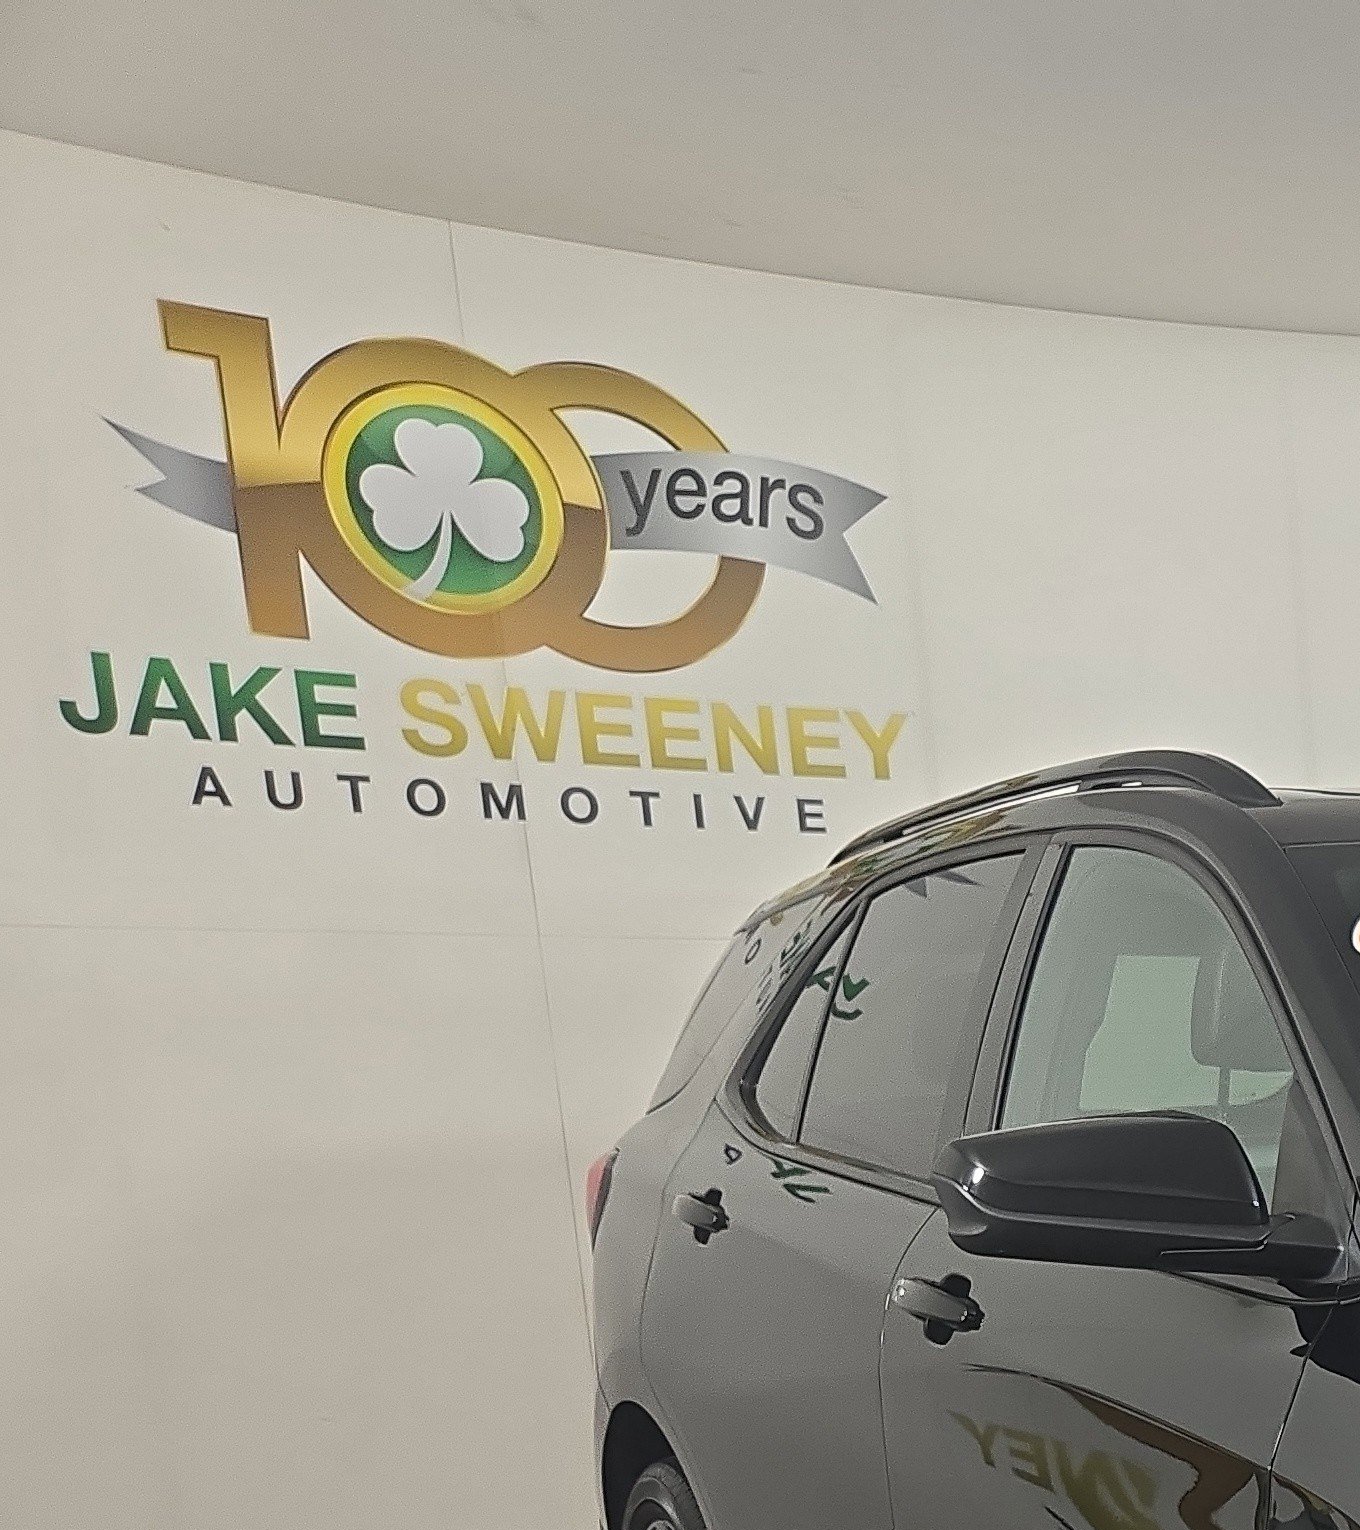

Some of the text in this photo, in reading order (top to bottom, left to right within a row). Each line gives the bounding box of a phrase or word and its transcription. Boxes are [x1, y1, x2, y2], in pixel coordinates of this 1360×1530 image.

[619, 466, 826, 541] years
[58, 650, 908, 782] JAKE SWEENEY
[190, 765, 828, 834] AUTOMOTIVE
